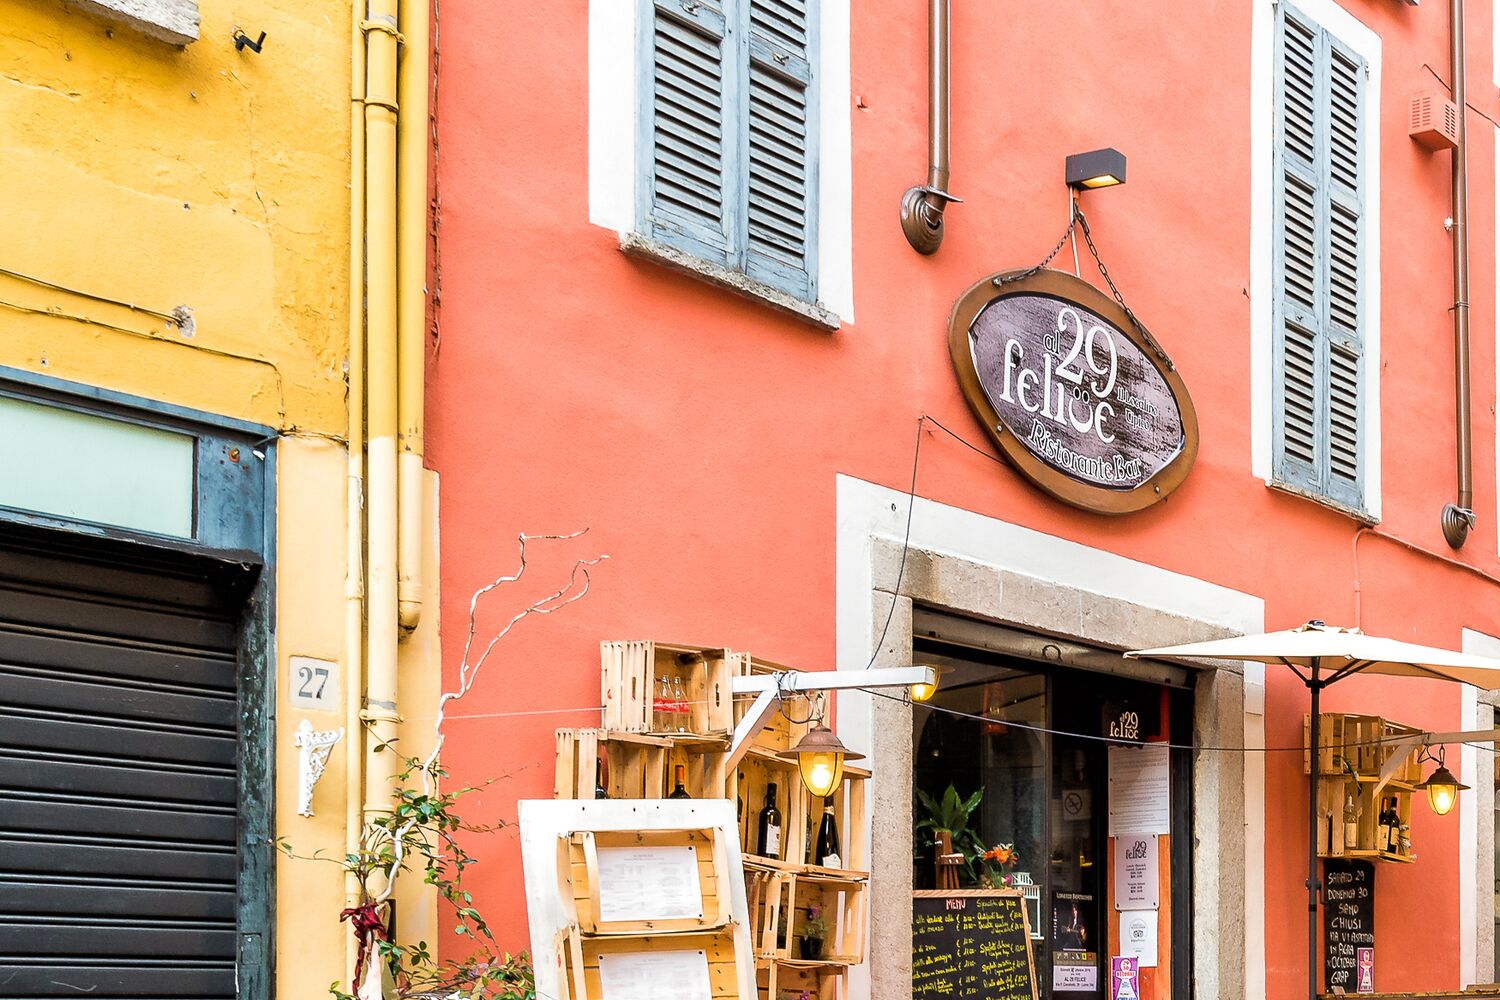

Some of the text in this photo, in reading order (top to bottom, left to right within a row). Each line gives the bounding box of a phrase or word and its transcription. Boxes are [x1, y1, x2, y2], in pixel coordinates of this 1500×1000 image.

[1043, 330, 1061, 356] al
[1055, 307, 1118, 398] 29
[999, 339, 1116, 443] felice
[1028, 418, 1143, 482] Ristorante Bar
[299, 667, 329, 699] 27
[1125, 711, 1139, 730] 29
[1135, 840, 1147, 852] 29
[1355, 870, 1365, 881] 29
[1328, 887, 1368, 900] DOMENICA 30
[1331, 917, 1362, 930] CHIUSI
[1331, 971, 1350, 984] GRAP
